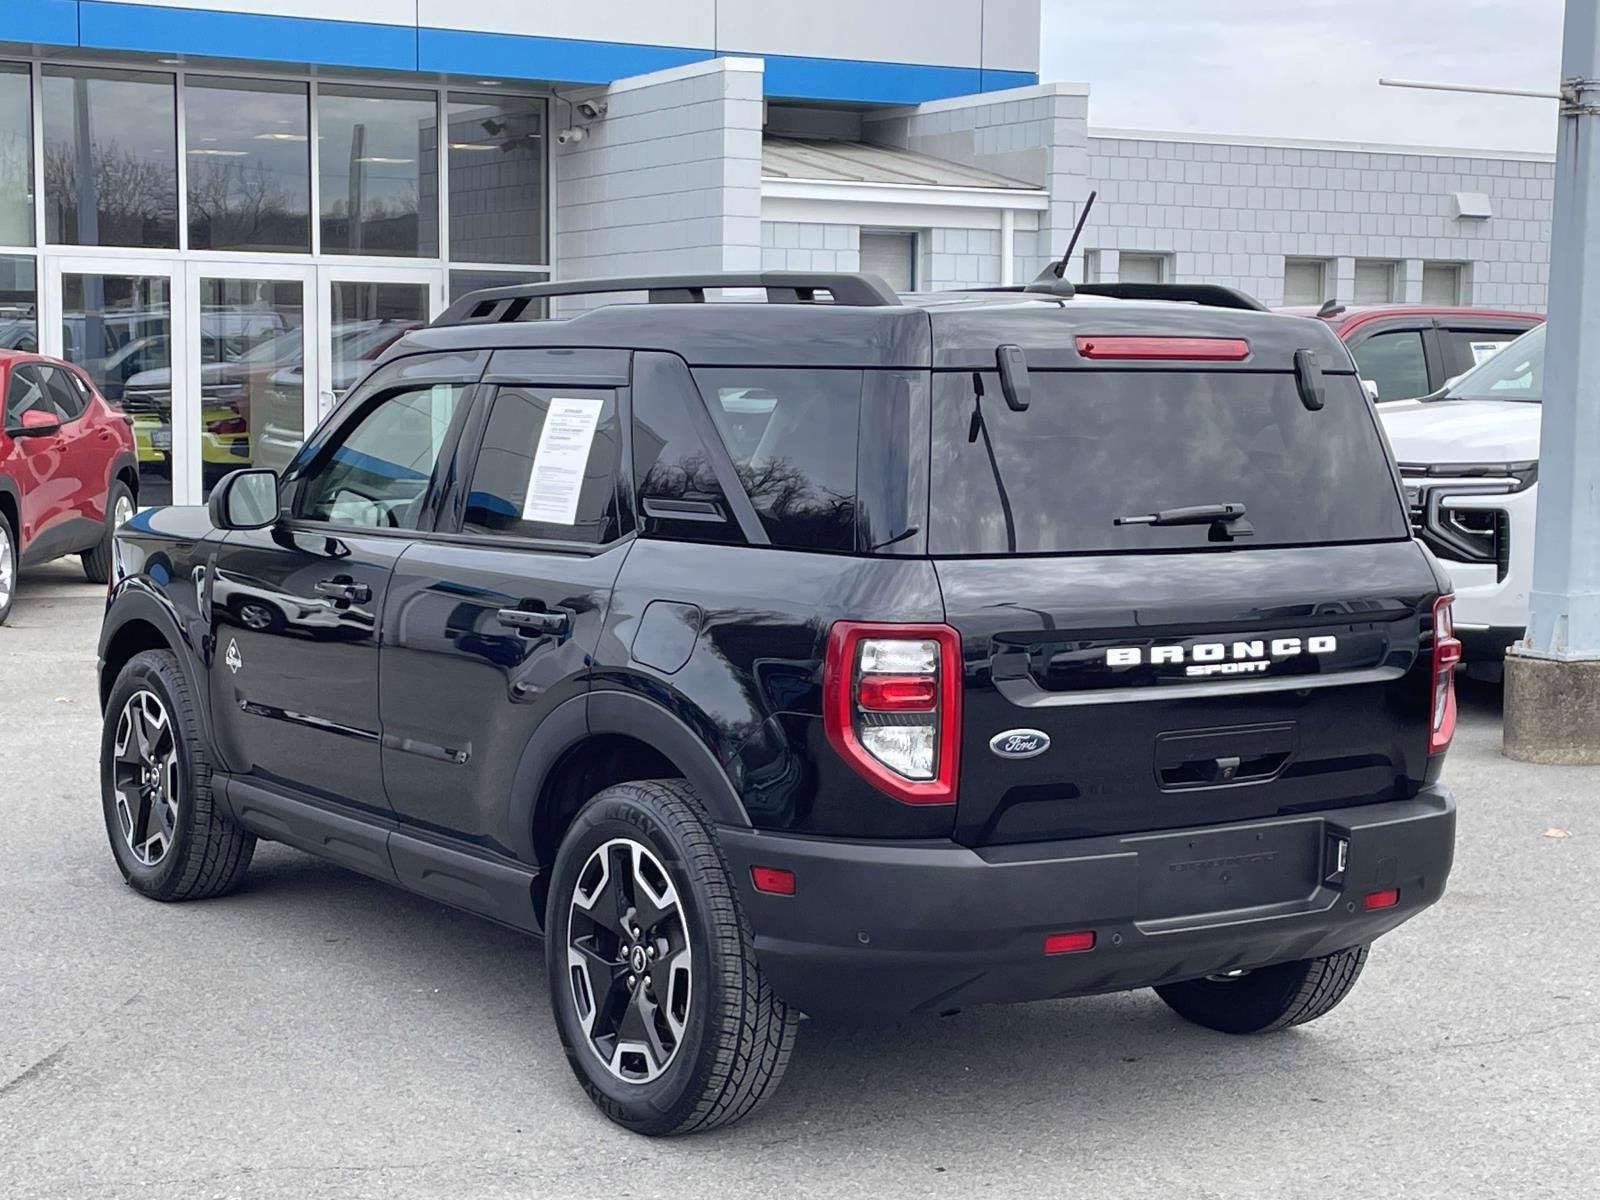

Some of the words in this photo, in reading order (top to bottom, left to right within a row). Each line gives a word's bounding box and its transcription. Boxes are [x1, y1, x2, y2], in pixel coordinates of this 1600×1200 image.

[1106, 636, 1337, 666] BRONCO
[1186, 660, 1271, 676] SPORT
[1005, 735, 1038, 751] Ford
